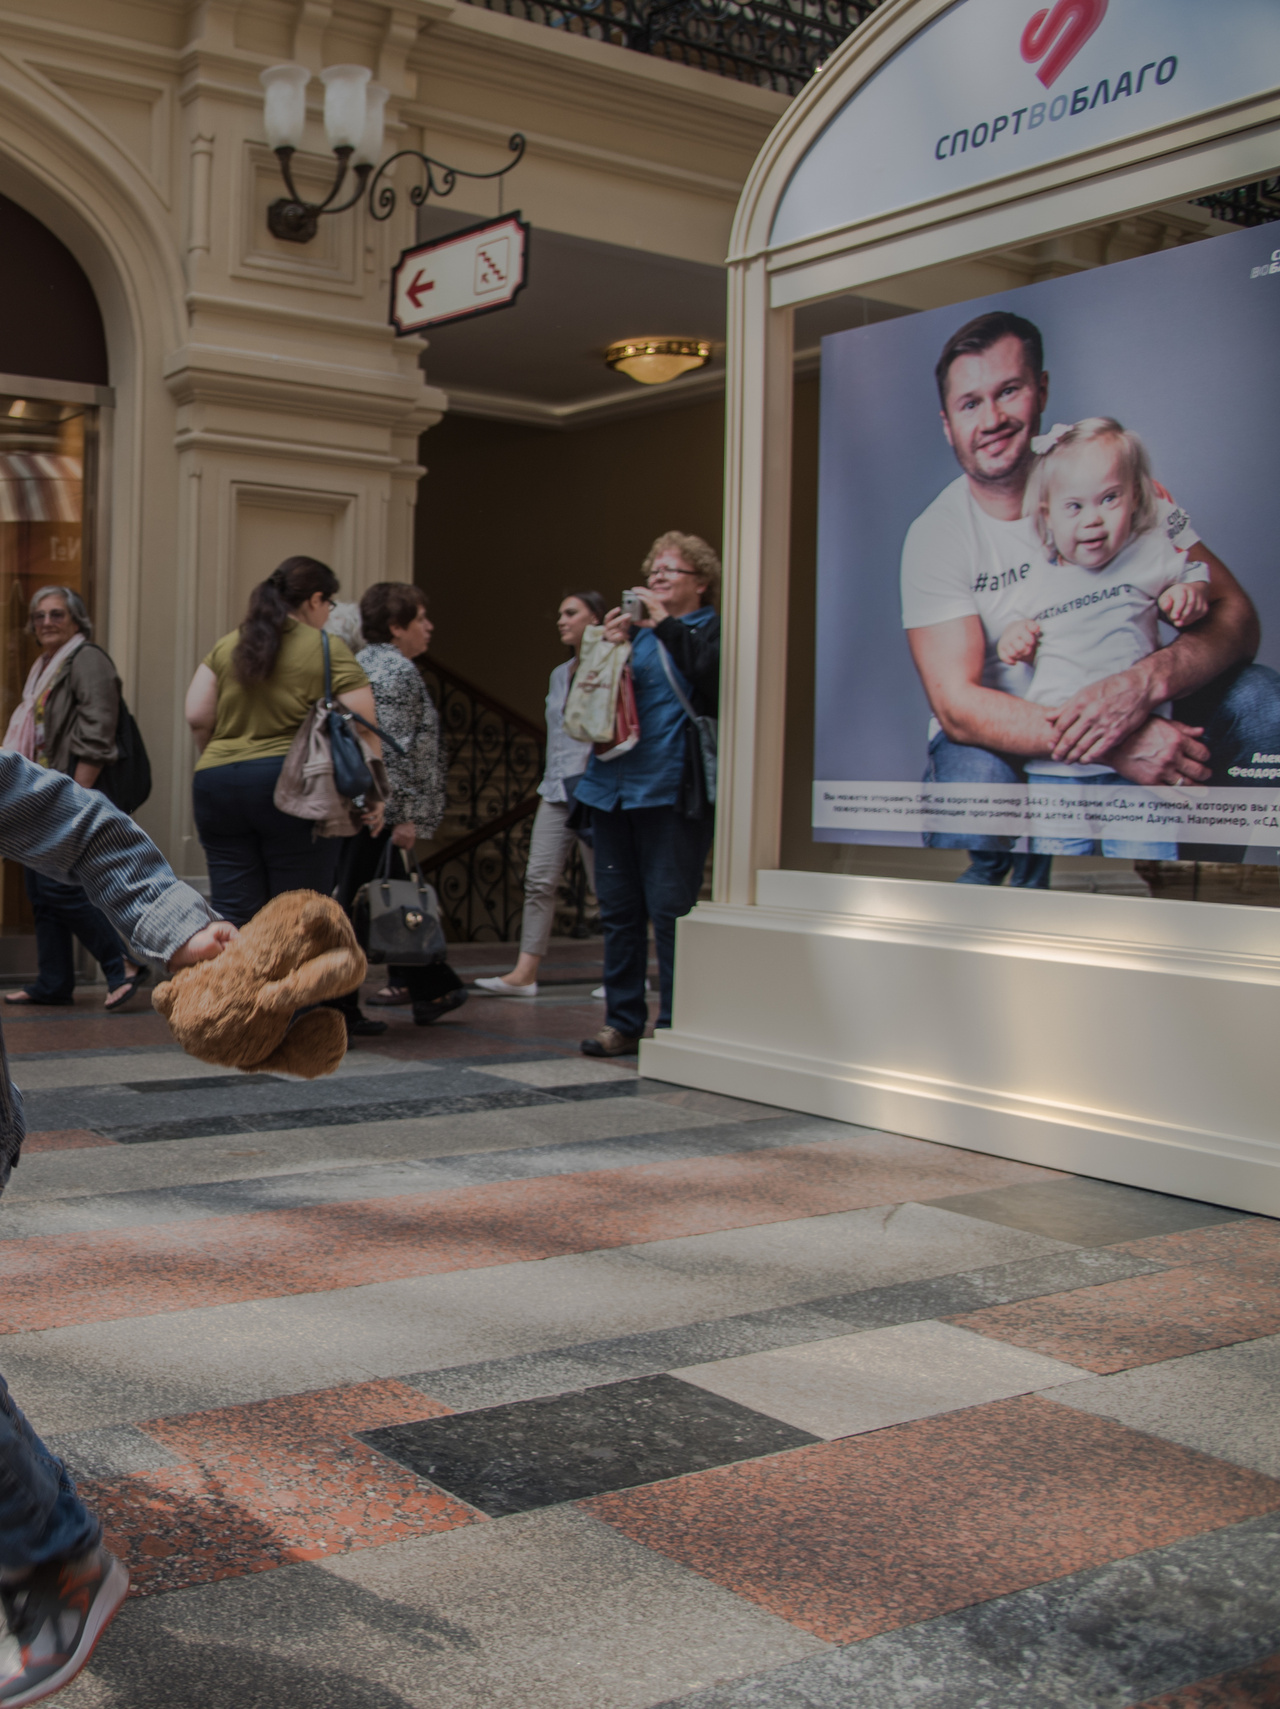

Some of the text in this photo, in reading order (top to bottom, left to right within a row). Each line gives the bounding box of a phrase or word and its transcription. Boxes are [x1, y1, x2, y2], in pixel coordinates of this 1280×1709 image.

[934, 55, 1179, 160] СПОРТВОБЛАГО
[1195, 801, 1248, 813] которую
[1250, 804, 1268, 812] вы
[1187, 814, 1250, 828] Например,
